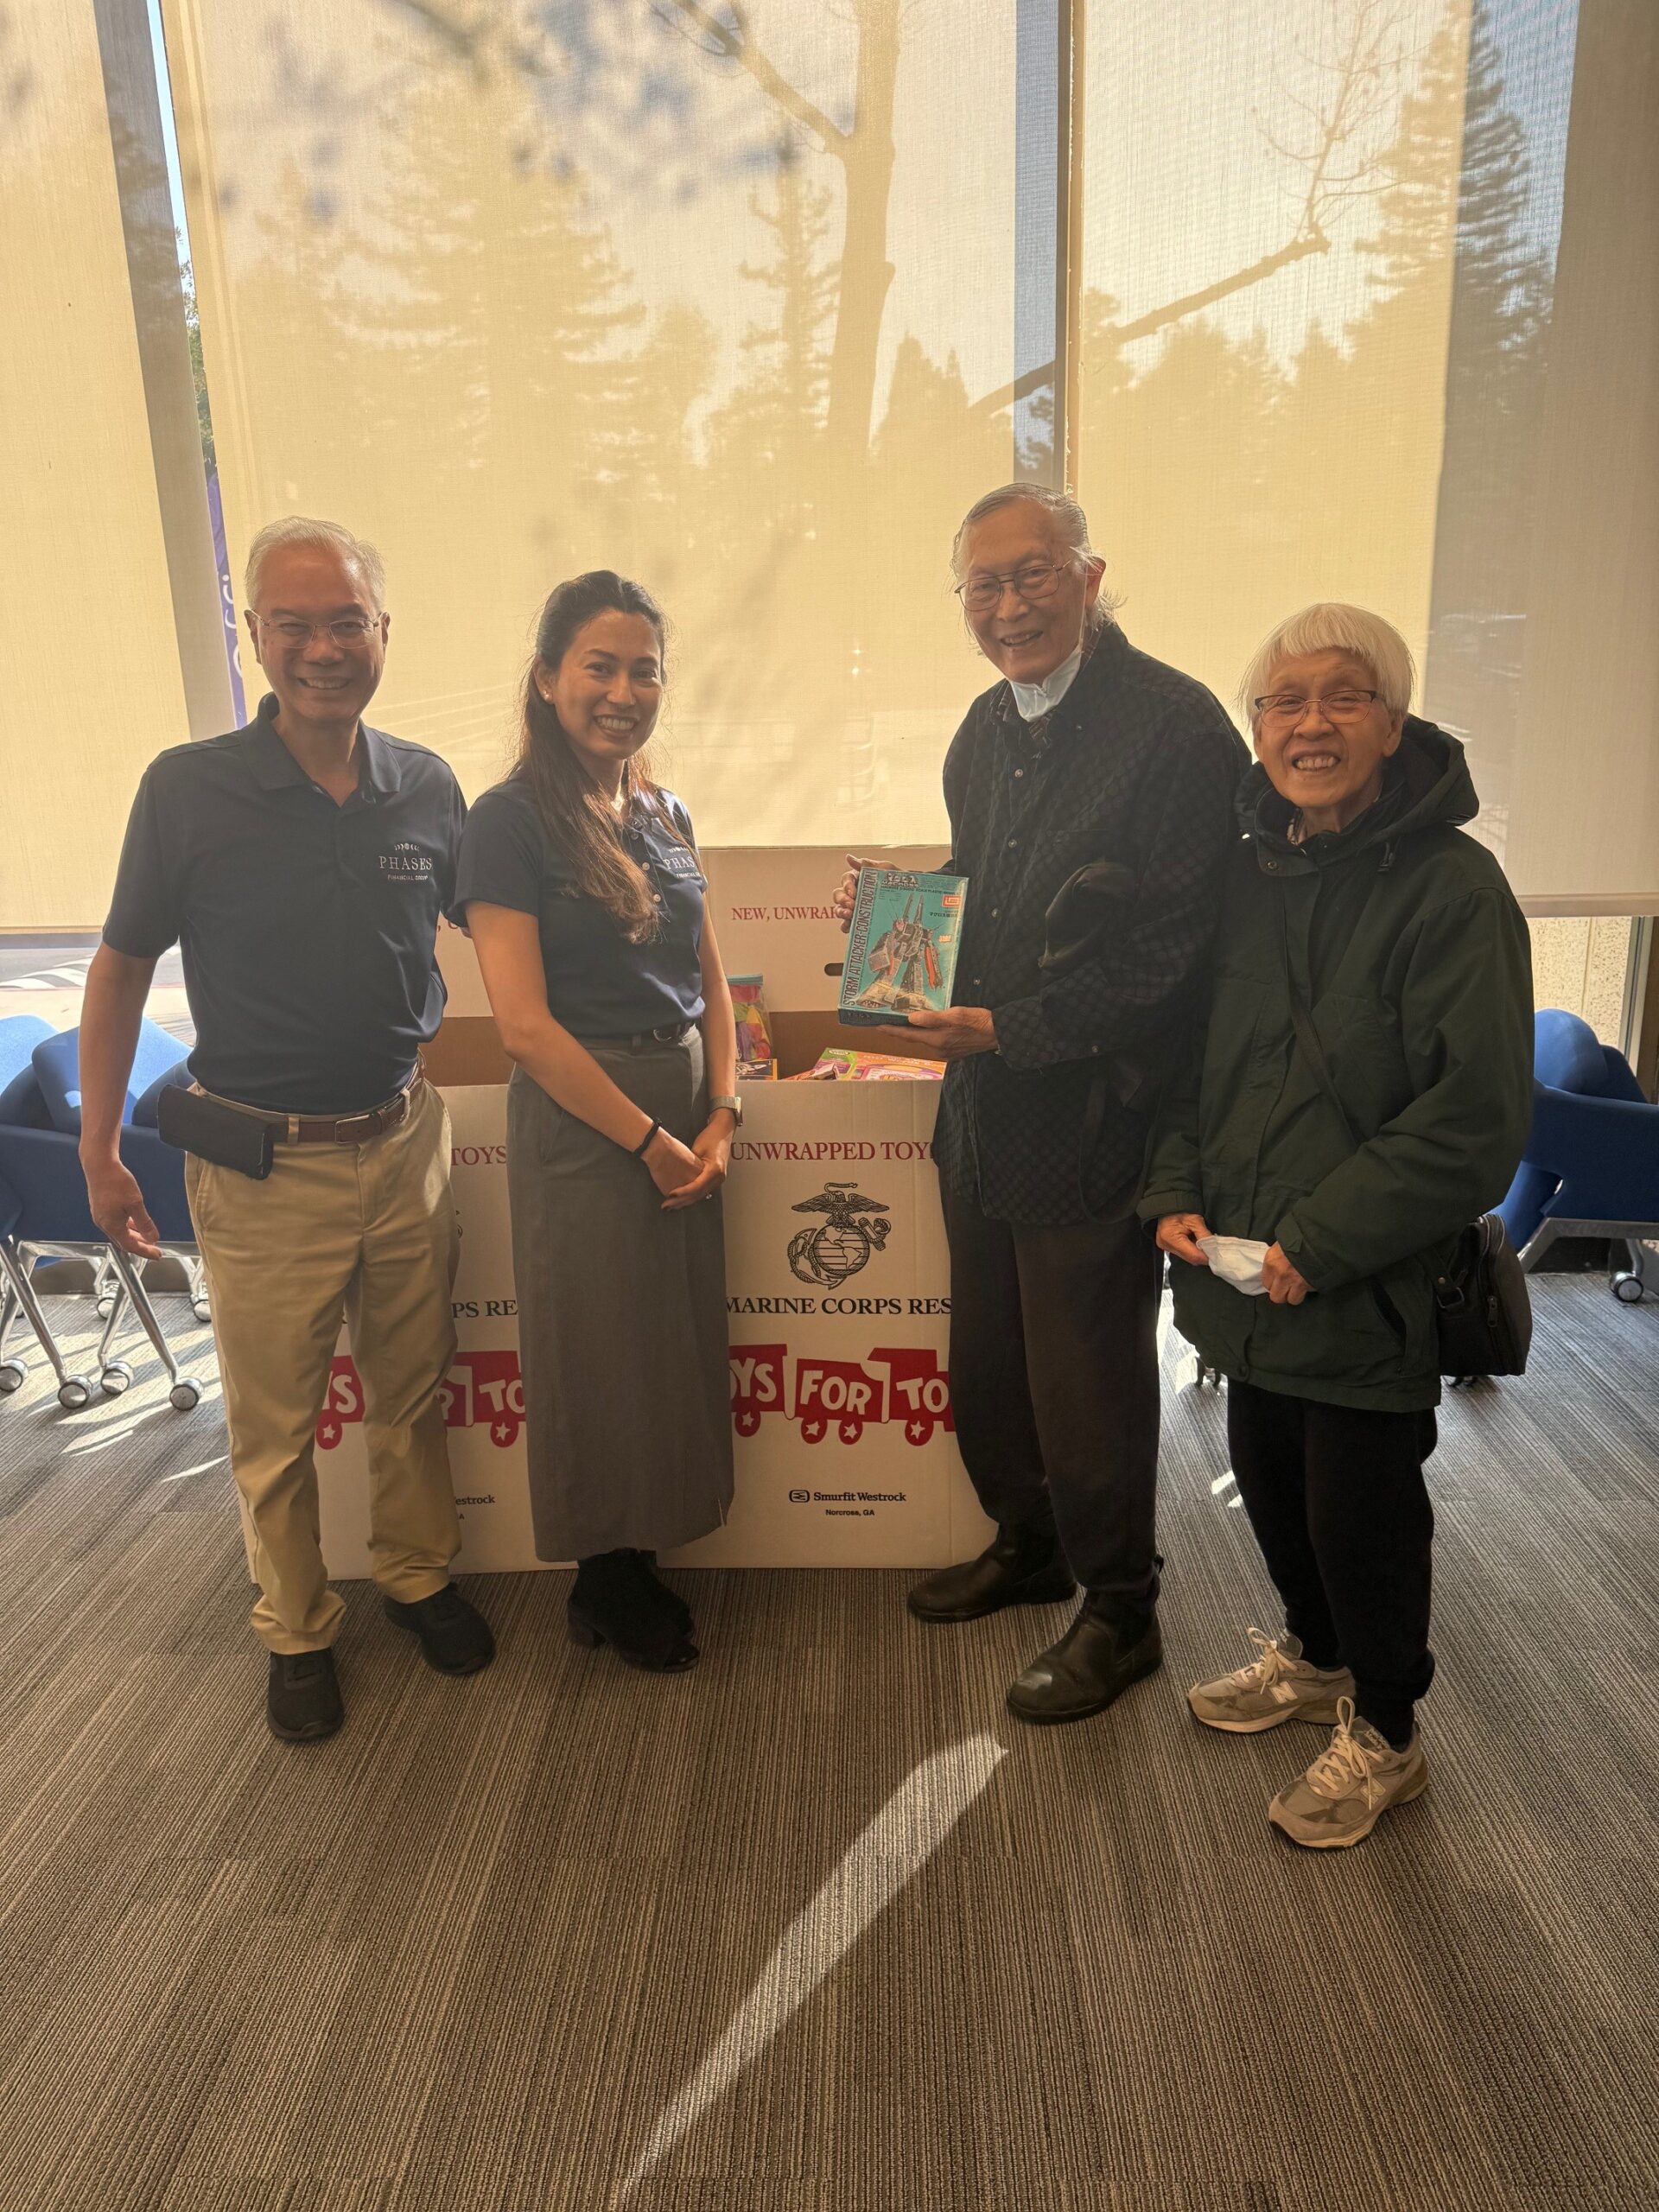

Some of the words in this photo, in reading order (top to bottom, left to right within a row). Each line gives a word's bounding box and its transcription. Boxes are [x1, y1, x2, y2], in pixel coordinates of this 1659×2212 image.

[378, 855, 433, 870] PHASES
[732, 907, 770, 922] NEW,
[843, 976, 860, 1006] STORM
[451, 1146, 506, 1166] TOYS
[730, 1141, 875, 1160] UNWRAPPED
[880, 1141, 932, 1160] TOY
[727, 1297, 817, 1314] MARINE
[821, 1298, 902, 1315] CORPS
[729, 1357, 777, 1402] YS
[799, 1370, 872, 1415] FOR
[813, 1491, 856, 1502] Smurfit
[856, 1492, 906, 1502] Westrock
